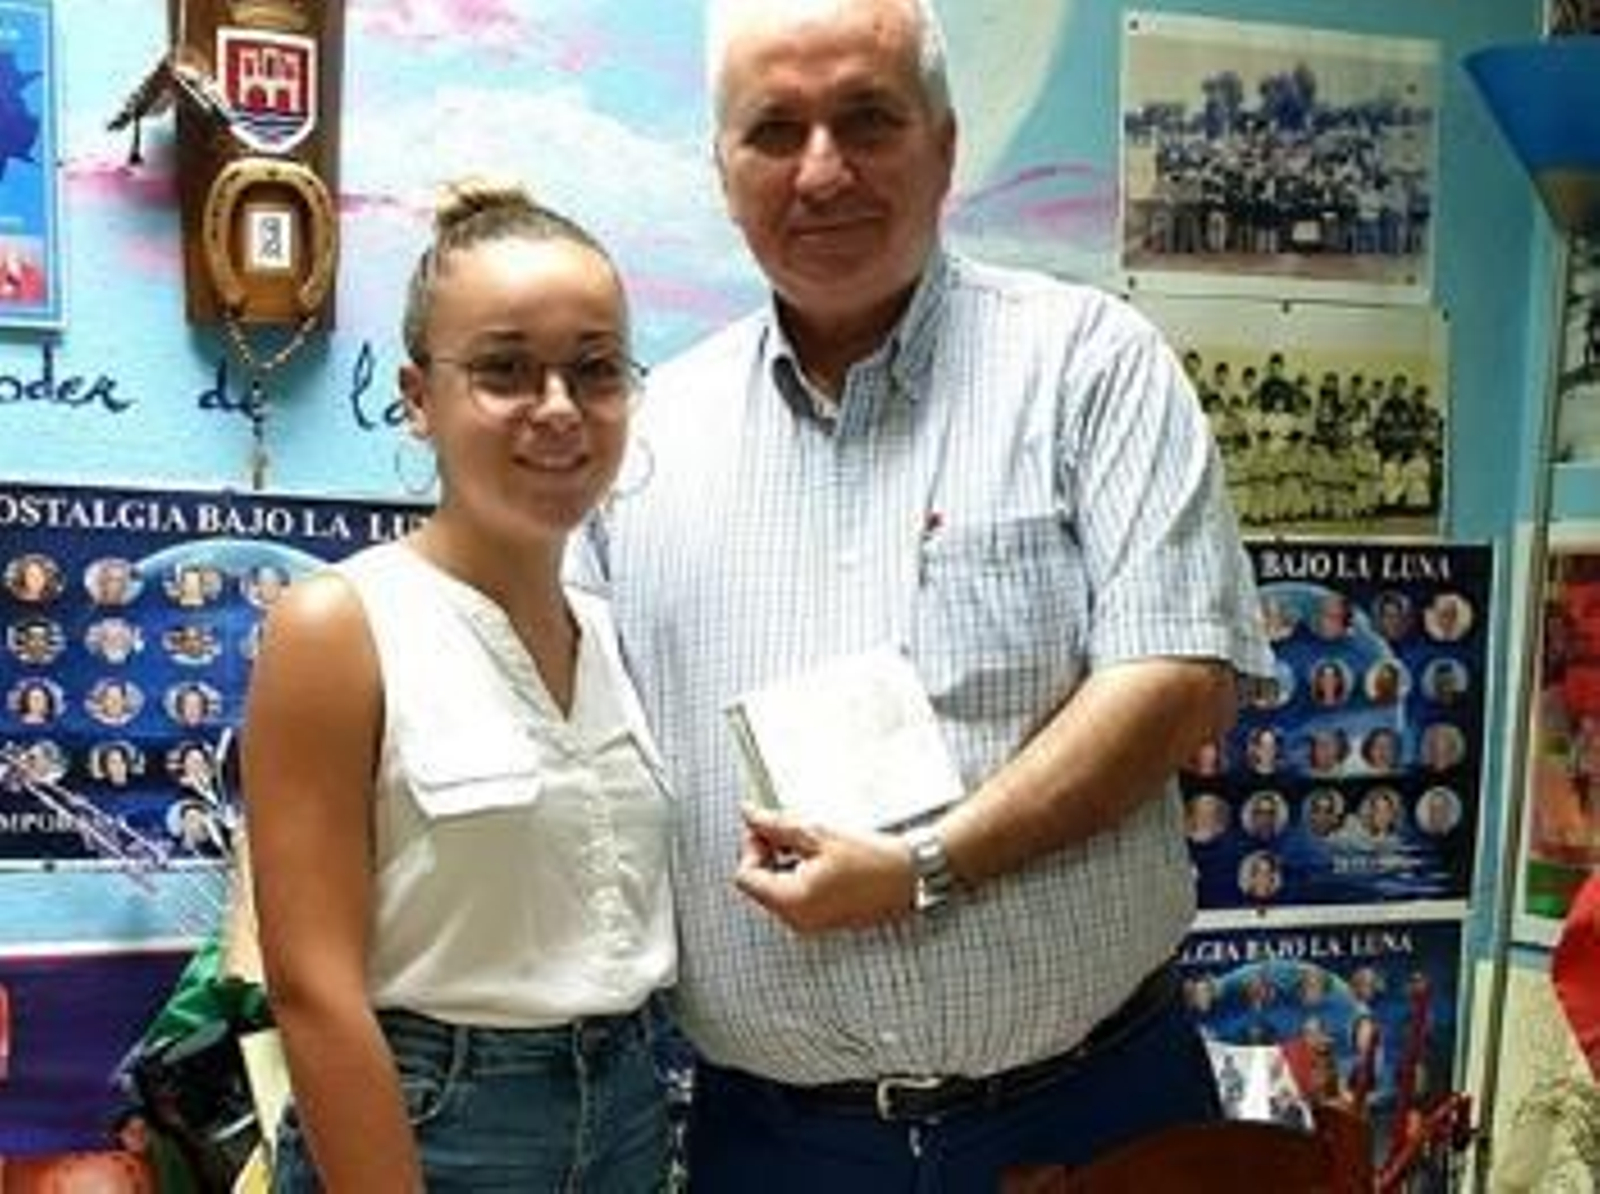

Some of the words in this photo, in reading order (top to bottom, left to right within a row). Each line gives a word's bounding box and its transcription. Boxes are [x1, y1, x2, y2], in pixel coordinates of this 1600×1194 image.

[197, 503, 296, 536] BAJO
[302, 508, 351, 540] LA
[1260, 552, 1331, 578] BAJO
[1336, 552, 1373, 580] LA
[1382, 553, 1453, 580] LUNA
